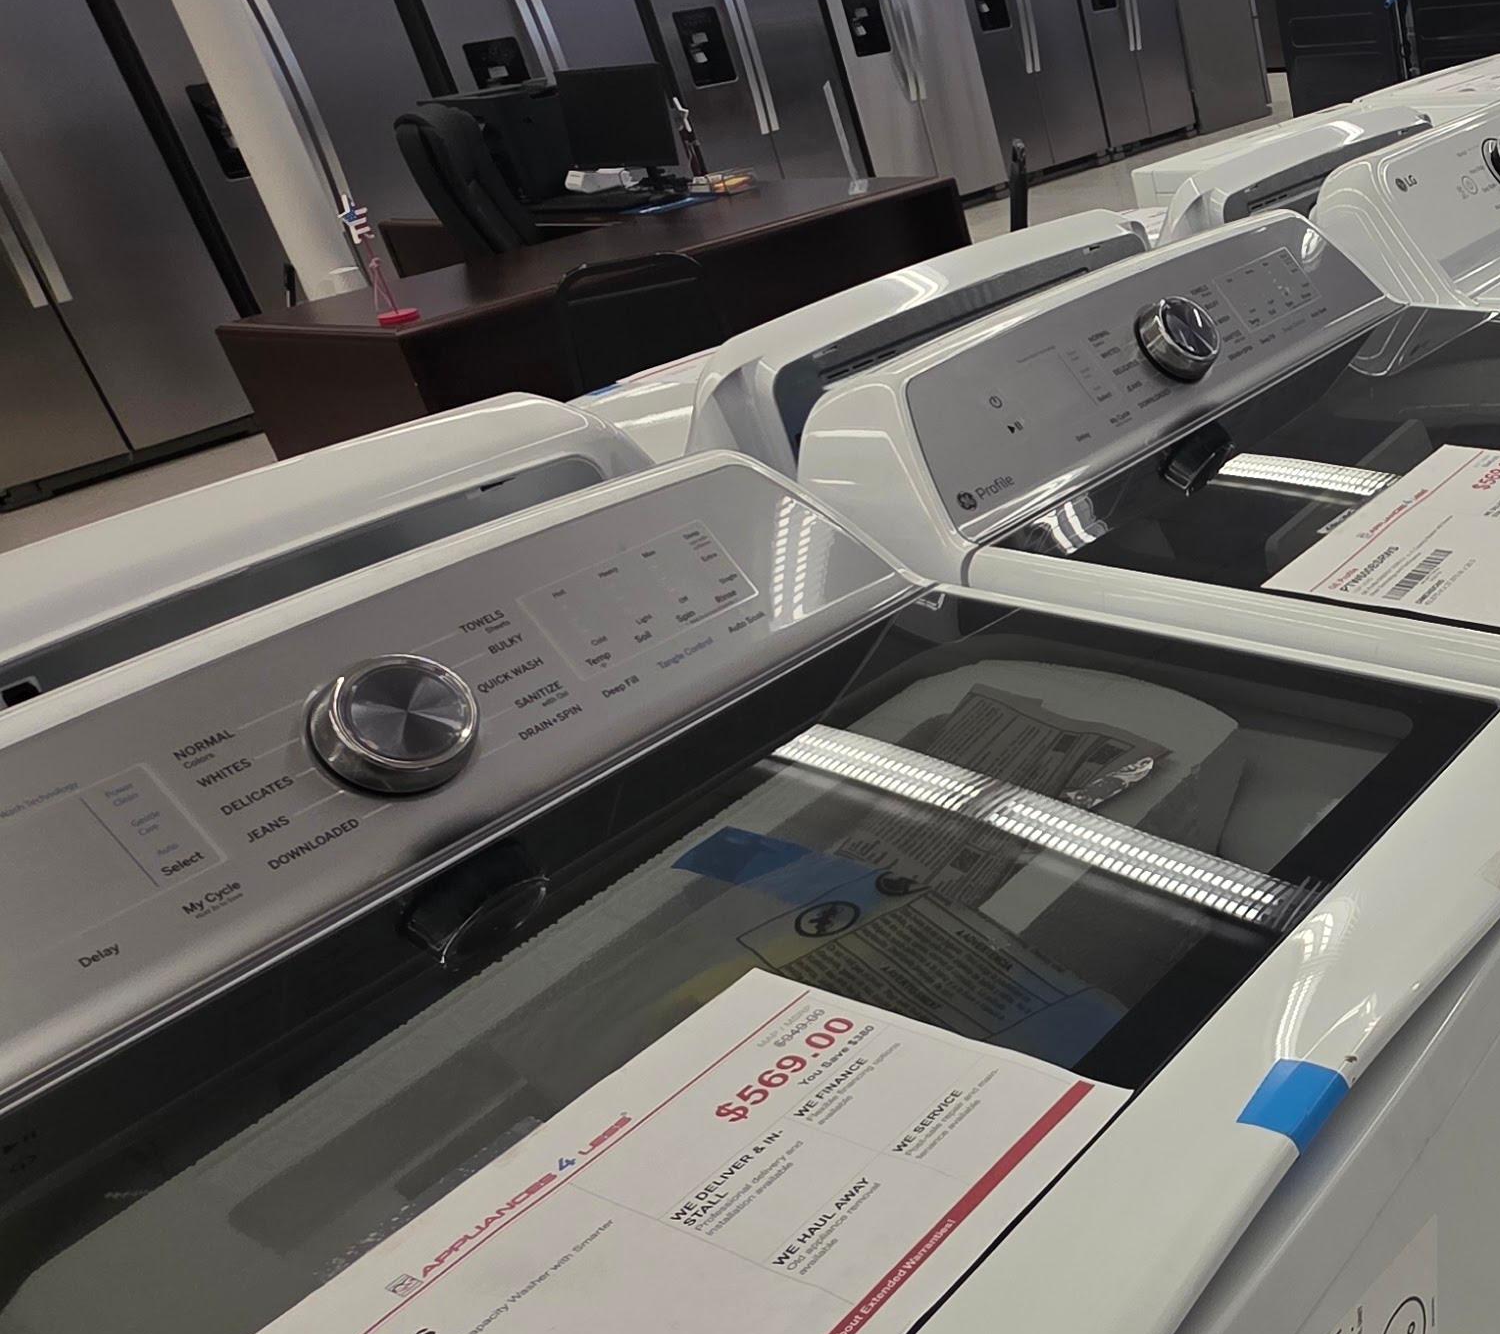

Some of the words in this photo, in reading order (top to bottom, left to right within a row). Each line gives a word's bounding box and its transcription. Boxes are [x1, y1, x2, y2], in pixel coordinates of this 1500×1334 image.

[975, 473, 1016, 501] Profile
[459, 609, 505, 634] TOWELS
[675, 609, 697, 624] Spin
[728, 619, 749, 634] Auto
[487, 633, 524, 655] BULKY
[634, 630, 653, 644] Soil
[656, 651, 686, 670] Tangle
[682, 636, 714, 658] Control
[477, 669, 513, 694] QUICK
[509, 657, 545, 681] WASH
[585, 651, 612, 668] Temp
[514, 680, 564, 709] SANITIZE
[601, 682, 626, 699] Deep
[623, 675, 640, 690] Fill
[518, 703, 584, 742] DRAIN+SPIN
[173, 729, 235, 761] NORMAL
[183, 751, 217, 770] Colors
[196, 757, 252, 789] WHITES
[219, 775, 295, 817] DELICATES
[246, 815, 291, 843] JEANS
[267, 818, 360, 871] DOWNLOADED
[160, 851, 205, 877] Select
[182, 898, 205, 917] My
[204, 879, 242, 905] Cycle
[77, 942, 121, 969] Delay
[715, 1017, 854, 1123] $569.00
[798, 1068, 823, 1086] You
[820, 1046, 850, 1068] Save
[847, 1025, 875, 1046] $380
[793, 1099, 818, 1118] WE
[815, 1056, 869, 1100] FINANCE
[892, 1134, 917, 1154] WE
[912, 1089, 964, 1135] SERVICE
[670, 1200, 698, 1223] WE
[694, 1153, 755, 1200] DELIVER
[752, 1144, 766, 1156] &
[763, 1129, 785, 1145] IN-
[694, 1184, 751, 1232] Professional
[750, 1155, 788, 1185] delivery
[786, 1139, 805, 1156] and
[423, 1172, 557, 1278] APPLIANCES
[558, 1157, 577, 1171] 4
[682, 1191, 730, 1227] STALL
[705, 1195, 755, 1237] installation
[754, 1161, 795, 1197] available
[772, 1243, 801, 1268] WE
[796, 1212, 838, 1245] HAUL
[834, 1176, 871, 1211] AWAY
[786, 1253, 807, 1272] Old
[805, 1215, 849, 1255] appliance
[845, 1181, 882, 1215] removal
[507, 1270, 551, 1305] Washer
[549, 1252, 574, 1272] with
[572, 1217, 614, 1253] Smarter
[799, 1237, 839, 1276] available
[860, 1268, 907, 1316] Extended
[902, 1218, 957, 1270] Warranties!
